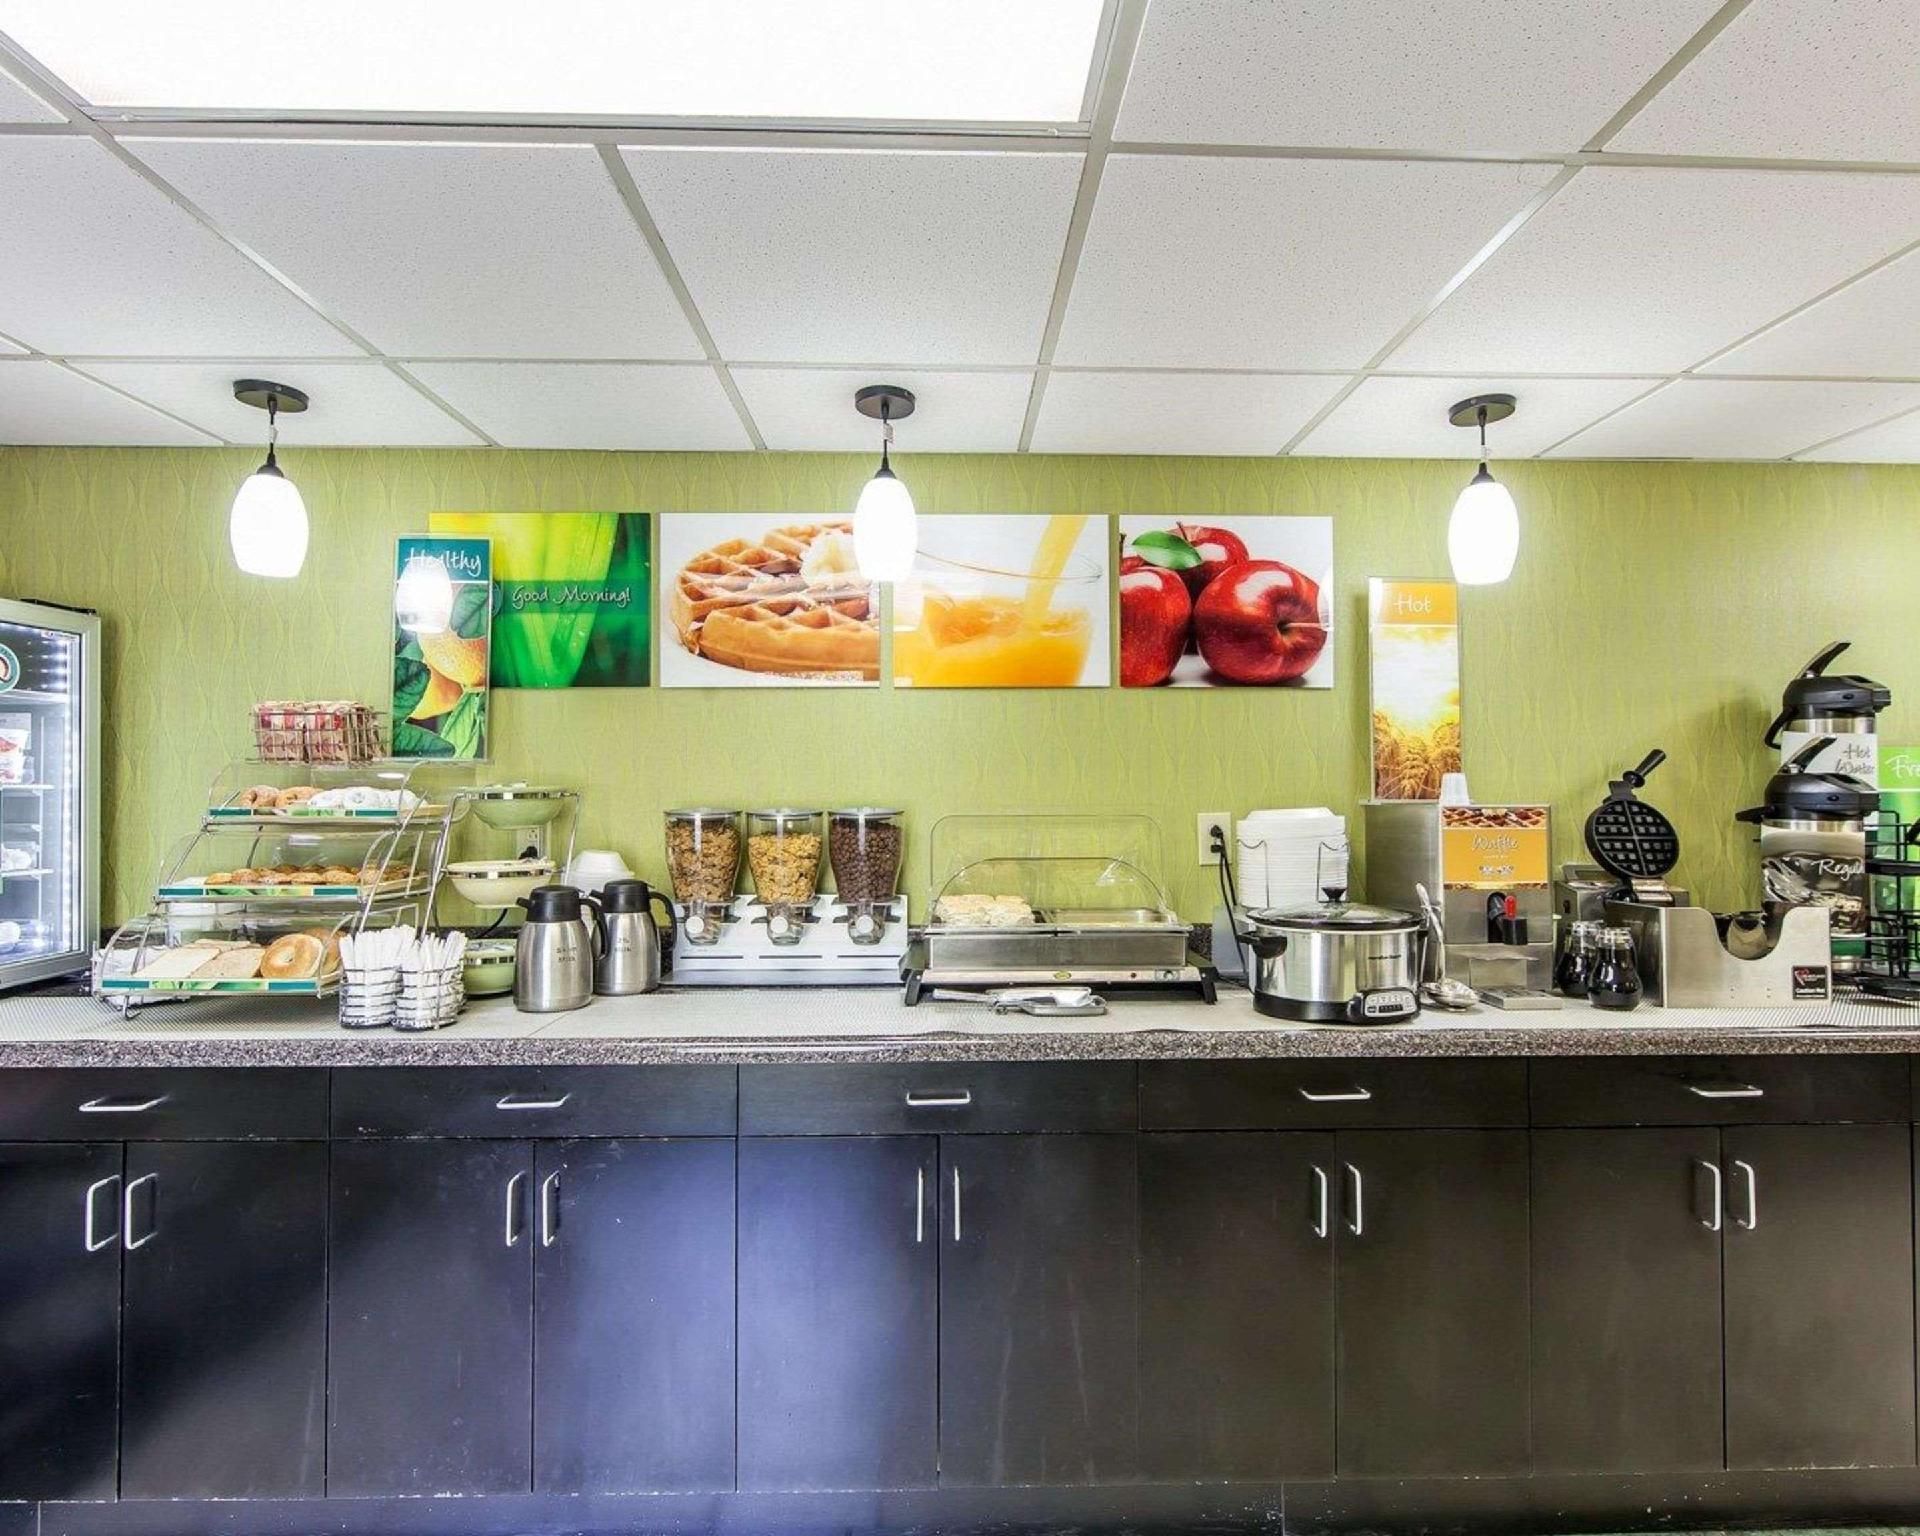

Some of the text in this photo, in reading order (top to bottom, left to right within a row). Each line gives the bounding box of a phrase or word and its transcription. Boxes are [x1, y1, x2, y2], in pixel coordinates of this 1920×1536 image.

[512, 584, 631, 610] Good Morning!
[1392, 593, 1433, 615] Hot
[1843, 743, 1871, 760] Hot
